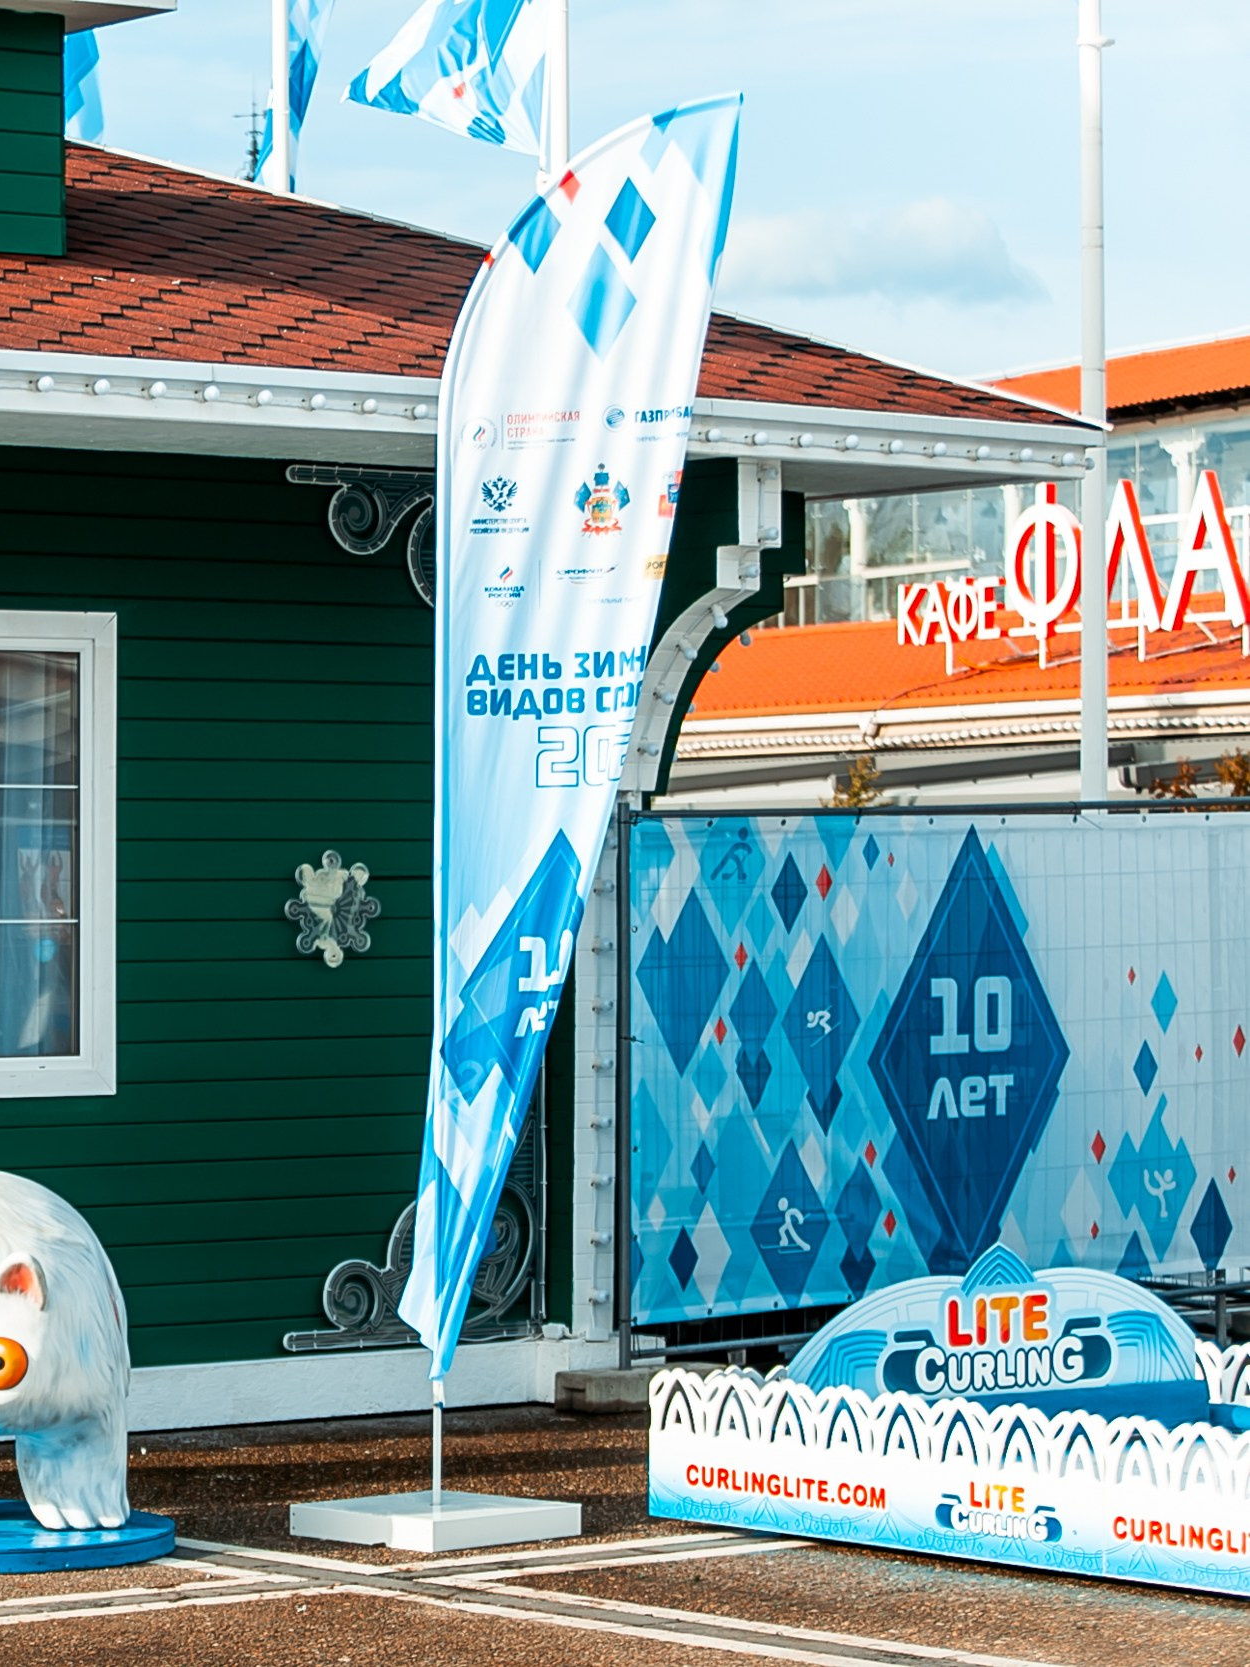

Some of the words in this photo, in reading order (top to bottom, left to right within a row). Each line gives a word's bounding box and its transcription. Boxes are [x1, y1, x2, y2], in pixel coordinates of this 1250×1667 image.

[898, 575, 1006, 646] КАФЕ
[466, 653, 562, 686] ДЕНЬ
[467, 687, 586, 720] ВИДОВ
[930, 976, 1012, 1055] 10
[947, 1294, 1049, 1347] LITE
[914, 1335, 1085, 1394] CURLING
[686, 1464, 887, 1510] CURLINGLITE.COM
[969, 1482, 1026, 1513] LITE
[949, 1503, 1049, 1543] CURLING
